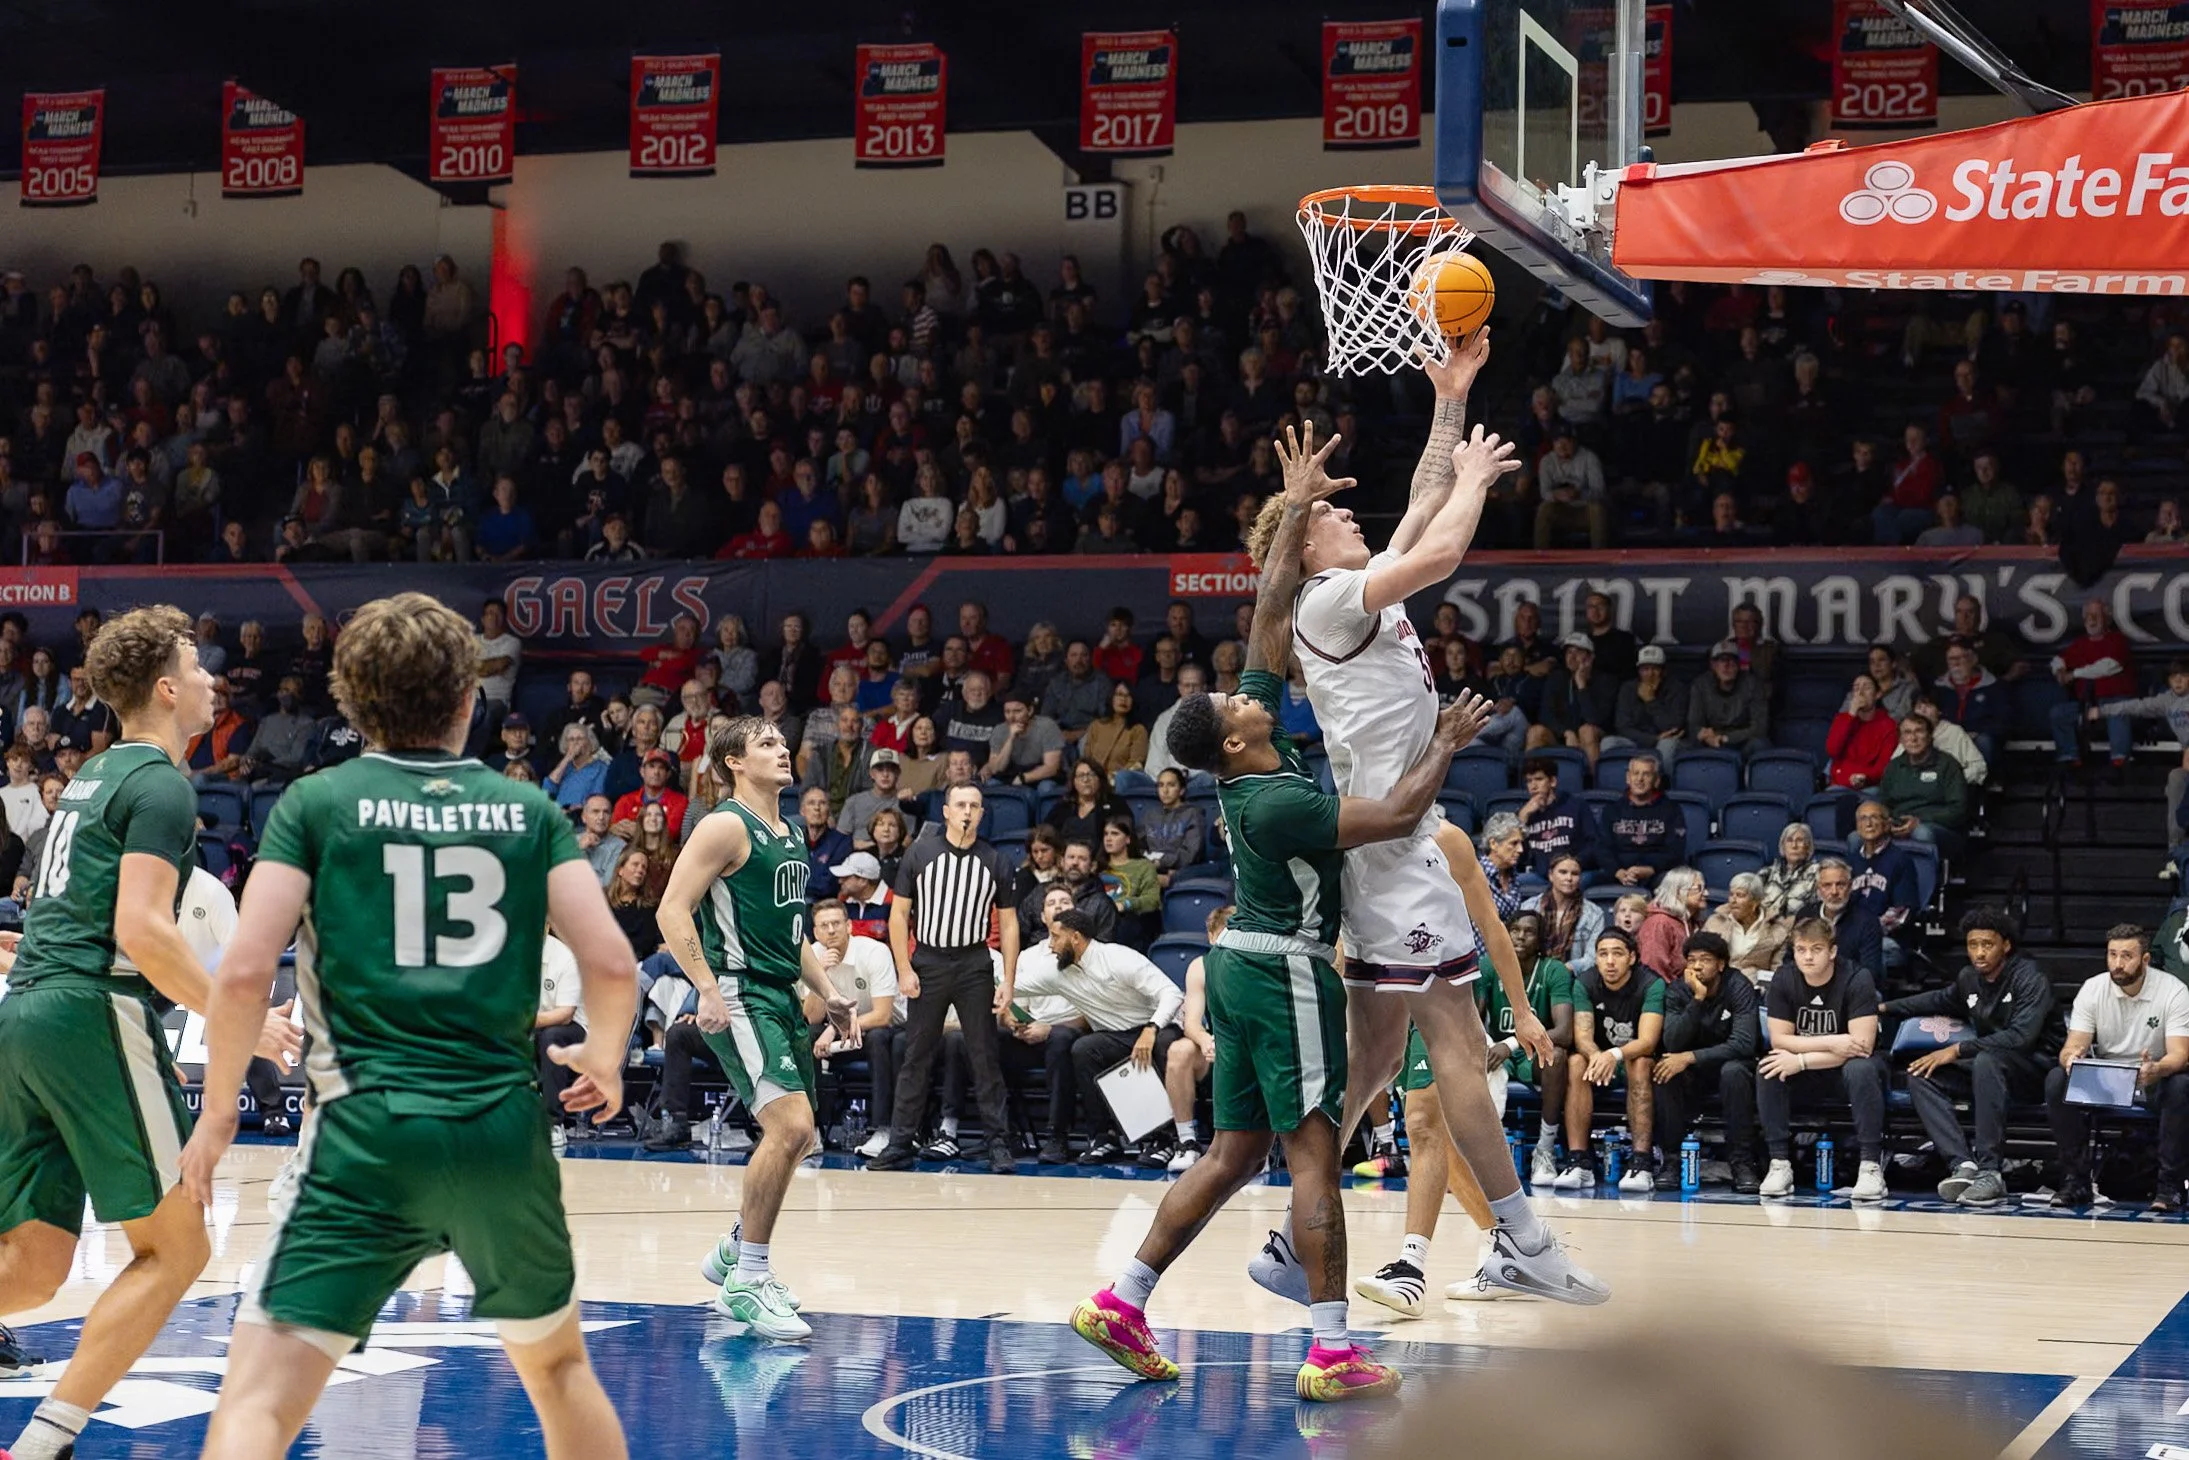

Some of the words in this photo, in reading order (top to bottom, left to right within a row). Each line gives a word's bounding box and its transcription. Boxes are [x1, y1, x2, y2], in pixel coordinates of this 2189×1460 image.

[2119, 9, 2168, 25] MARCH
[2125, 21, 2189, 40] MADNESS
[1107, 51, 1150, 65] MARCH
[1347, 40, 1393, 56] MARCH
[879, 63, 921, 77] MARCH
[1111, 63, 1168, 81] MADNESS
[1352, 53, 1412, 71] MADNESS
[654, 74, 694, 88] MARCH
[883, 74, 939, 92] MADNESS
[452, 86, 491, 100] MARCH
[457, 96, 508, 113] MADNESS
[657, 85, 710, 102] MADNESS
[1840, 82, 1928, 117] 2022
[44, 109, 81, 125] MARCH
[244, 98, 279, 113] MAR
[47, 120, 94, 137] MADNESS
[1092, 113, 1163, 146] 2017
[1333, 104, 1408, 137] 2019
[640, 133, 707, 165] 2012
[865, 124, 935, 156] 2013
[229, 155, 297, 187] 2008
[440, 144, 503, 176] 2010
[28, 164, 94, 196] 2005
[1945, 154, 2122, 222] State
[2126, 152, 2189, 217] Fa
[1066, 190, 1118, 220] BB
[1845, 270, 2014, 292] State
[2022, 269, 2187, 296] Farm
[0, 585, 55, 602] CTION
[59, 583, 71, 601] B
[1174, 573, 1261, 593] SECTION
[504, 576, 710, 638] GAELS
[1443, 577, 1692, 646] SAINT
[1721, 566, 2068, 646] MARY'S
[358, 798, 528, 832] PAVELETZKE
[383, 843, 509, 968] 13
[791, 913, 804, 946] 0
[1796, 1006, 1838, 1036] OHIO
